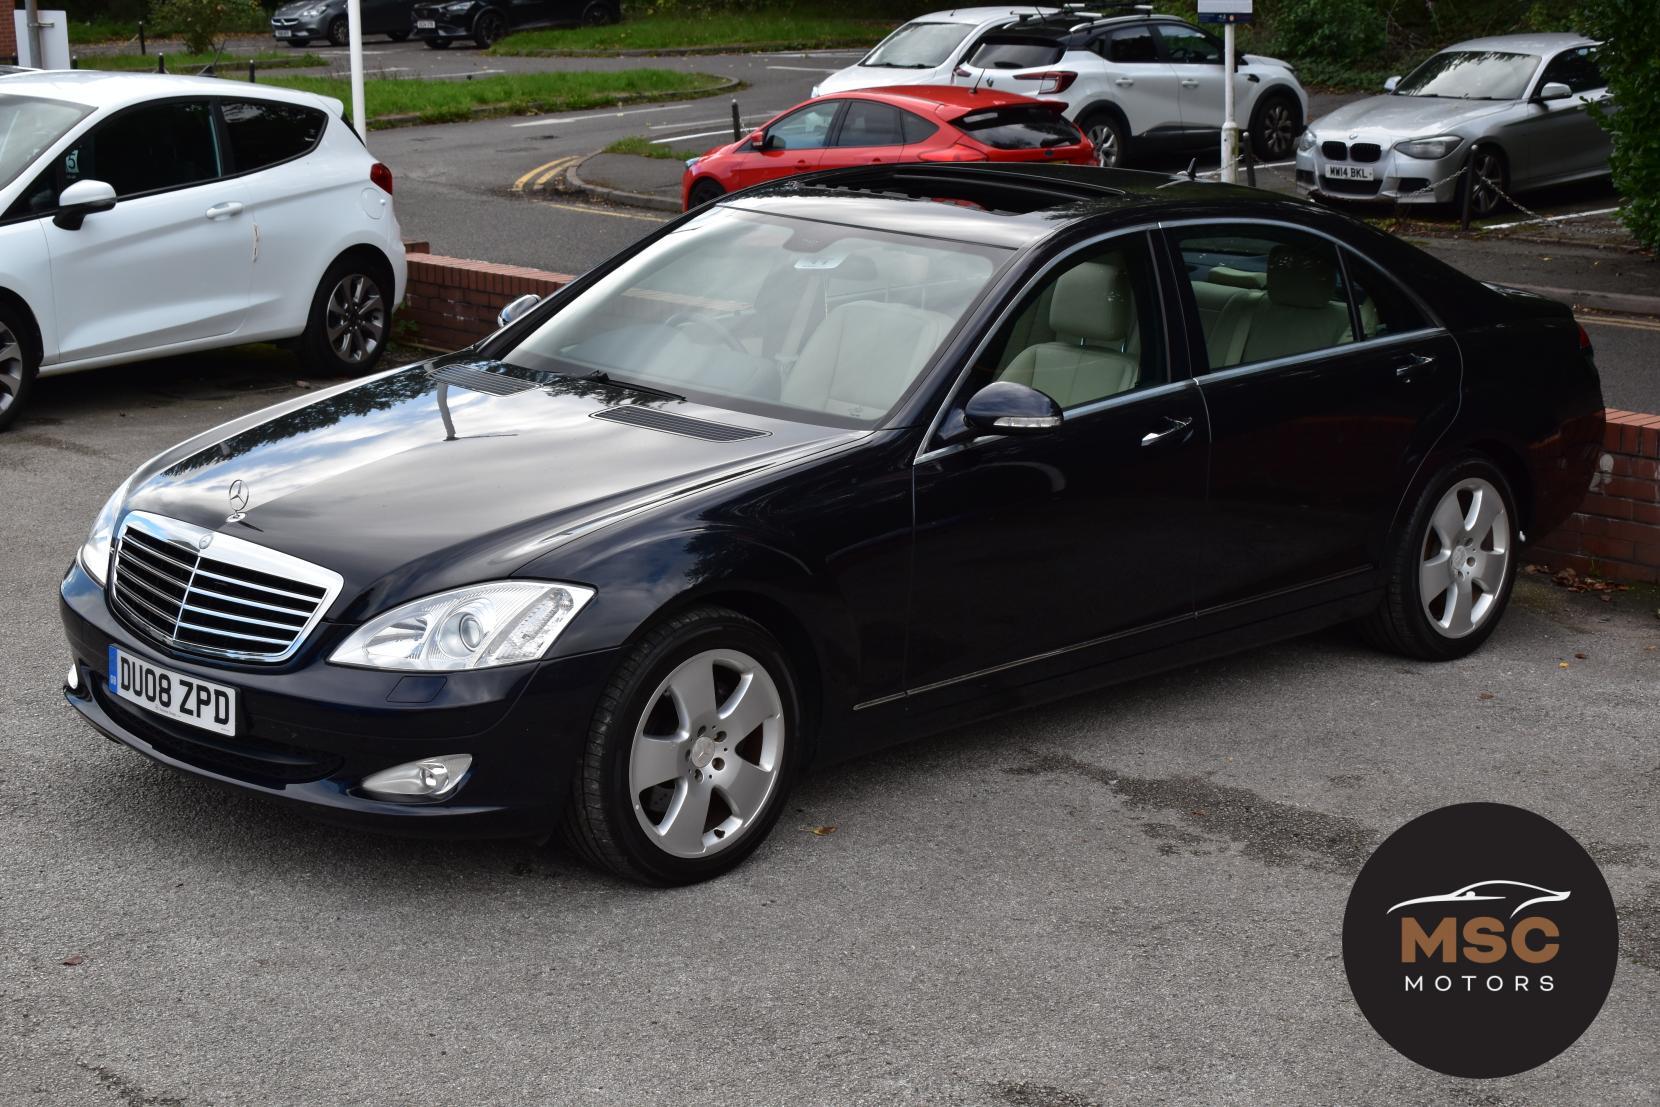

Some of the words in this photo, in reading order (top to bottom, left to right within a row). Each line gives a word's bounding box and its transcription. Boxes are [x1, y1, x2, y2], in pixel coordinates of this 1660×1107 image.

[1350, 167, 1368, 179] BKL
[121, 656, 172, 708] DU08
[179, 679, 230, 725] ZPD
